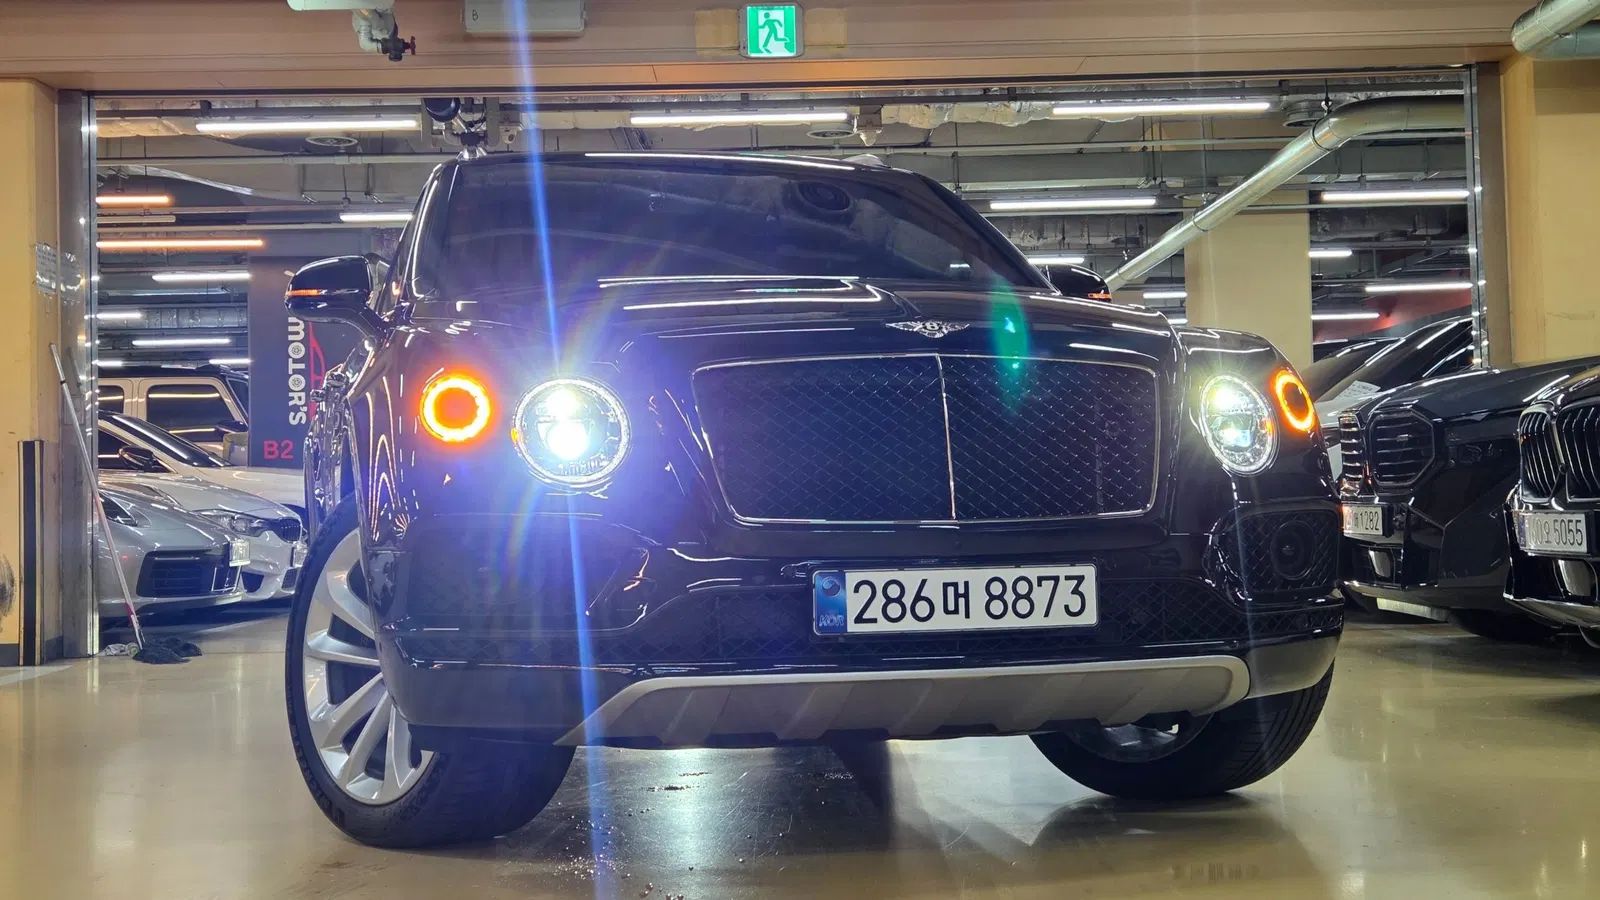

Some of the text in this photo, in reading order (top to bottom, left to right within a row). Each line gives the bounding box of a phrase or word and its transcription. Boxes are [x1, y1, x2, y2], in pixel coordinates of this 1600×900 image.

[263, 440, 295, 460] B2
[1359, 510, 1380, 531] 1282
[1553, 518, 1584, 547] 5055
[853, 575, 1087, 624] 286머 8873
[818, 614, 845, 627] KOR
